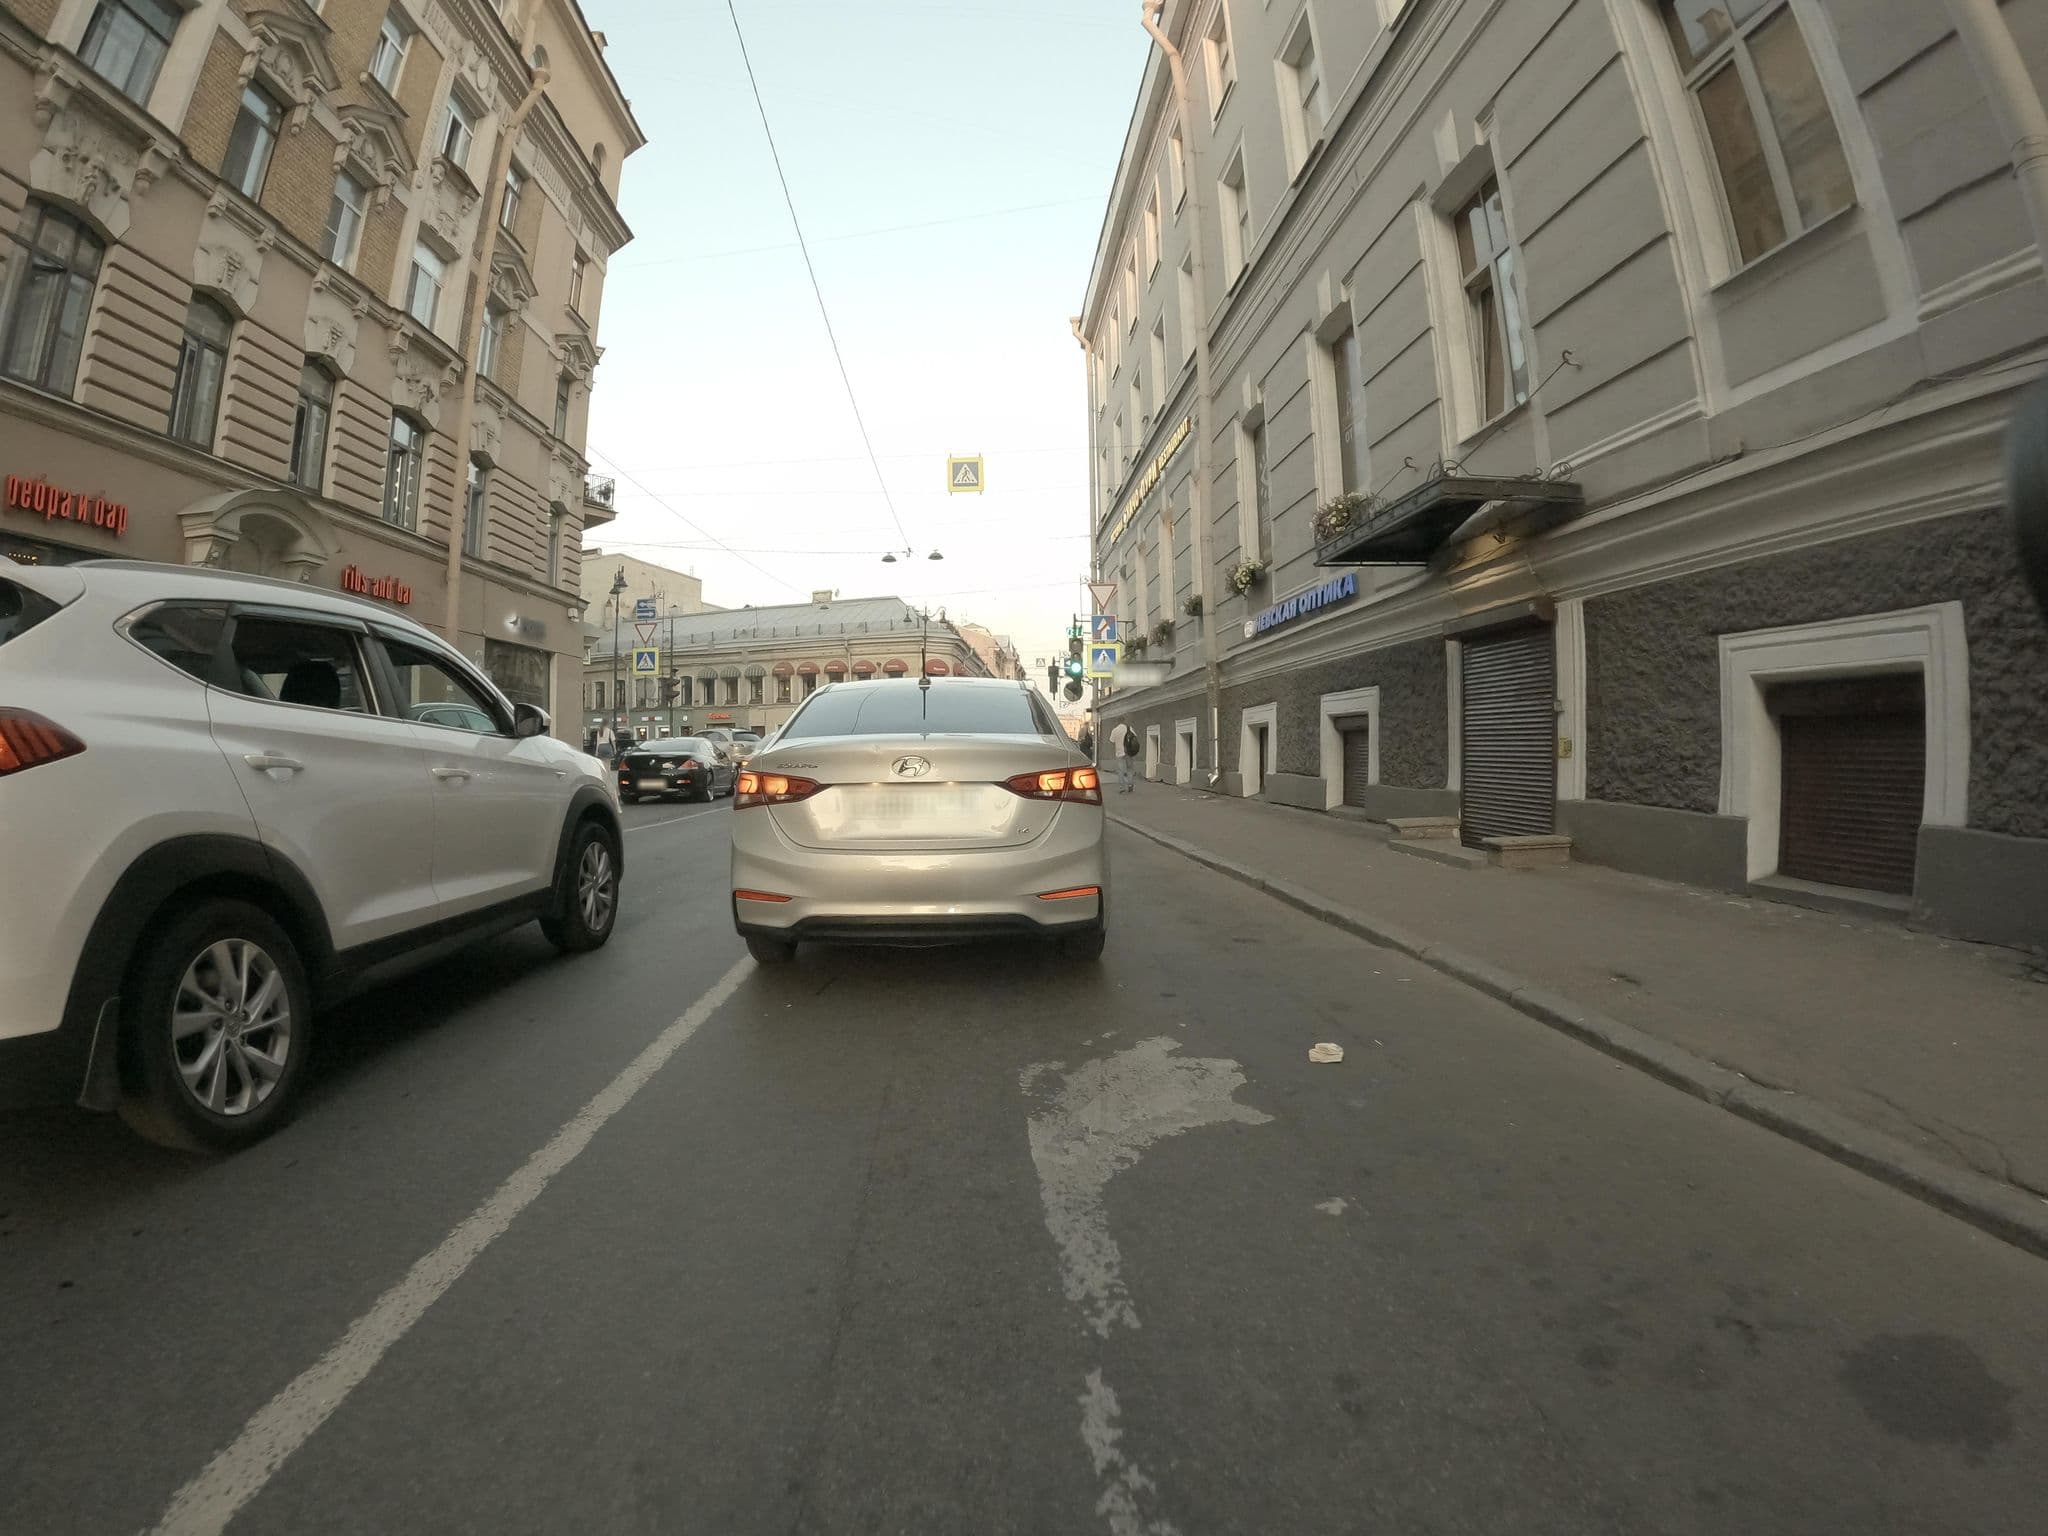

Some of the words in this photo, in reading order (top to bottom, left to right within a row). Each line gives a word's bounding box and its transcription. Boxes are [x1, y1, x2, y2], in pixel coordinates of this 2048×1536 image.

[77, 494, 89, 522] и
[373, 575, 393, 600] and
[1255, 598, 1297, 632] НЕВСКАЯ
[1298, 573, 1357, 614] ОПТИКА
